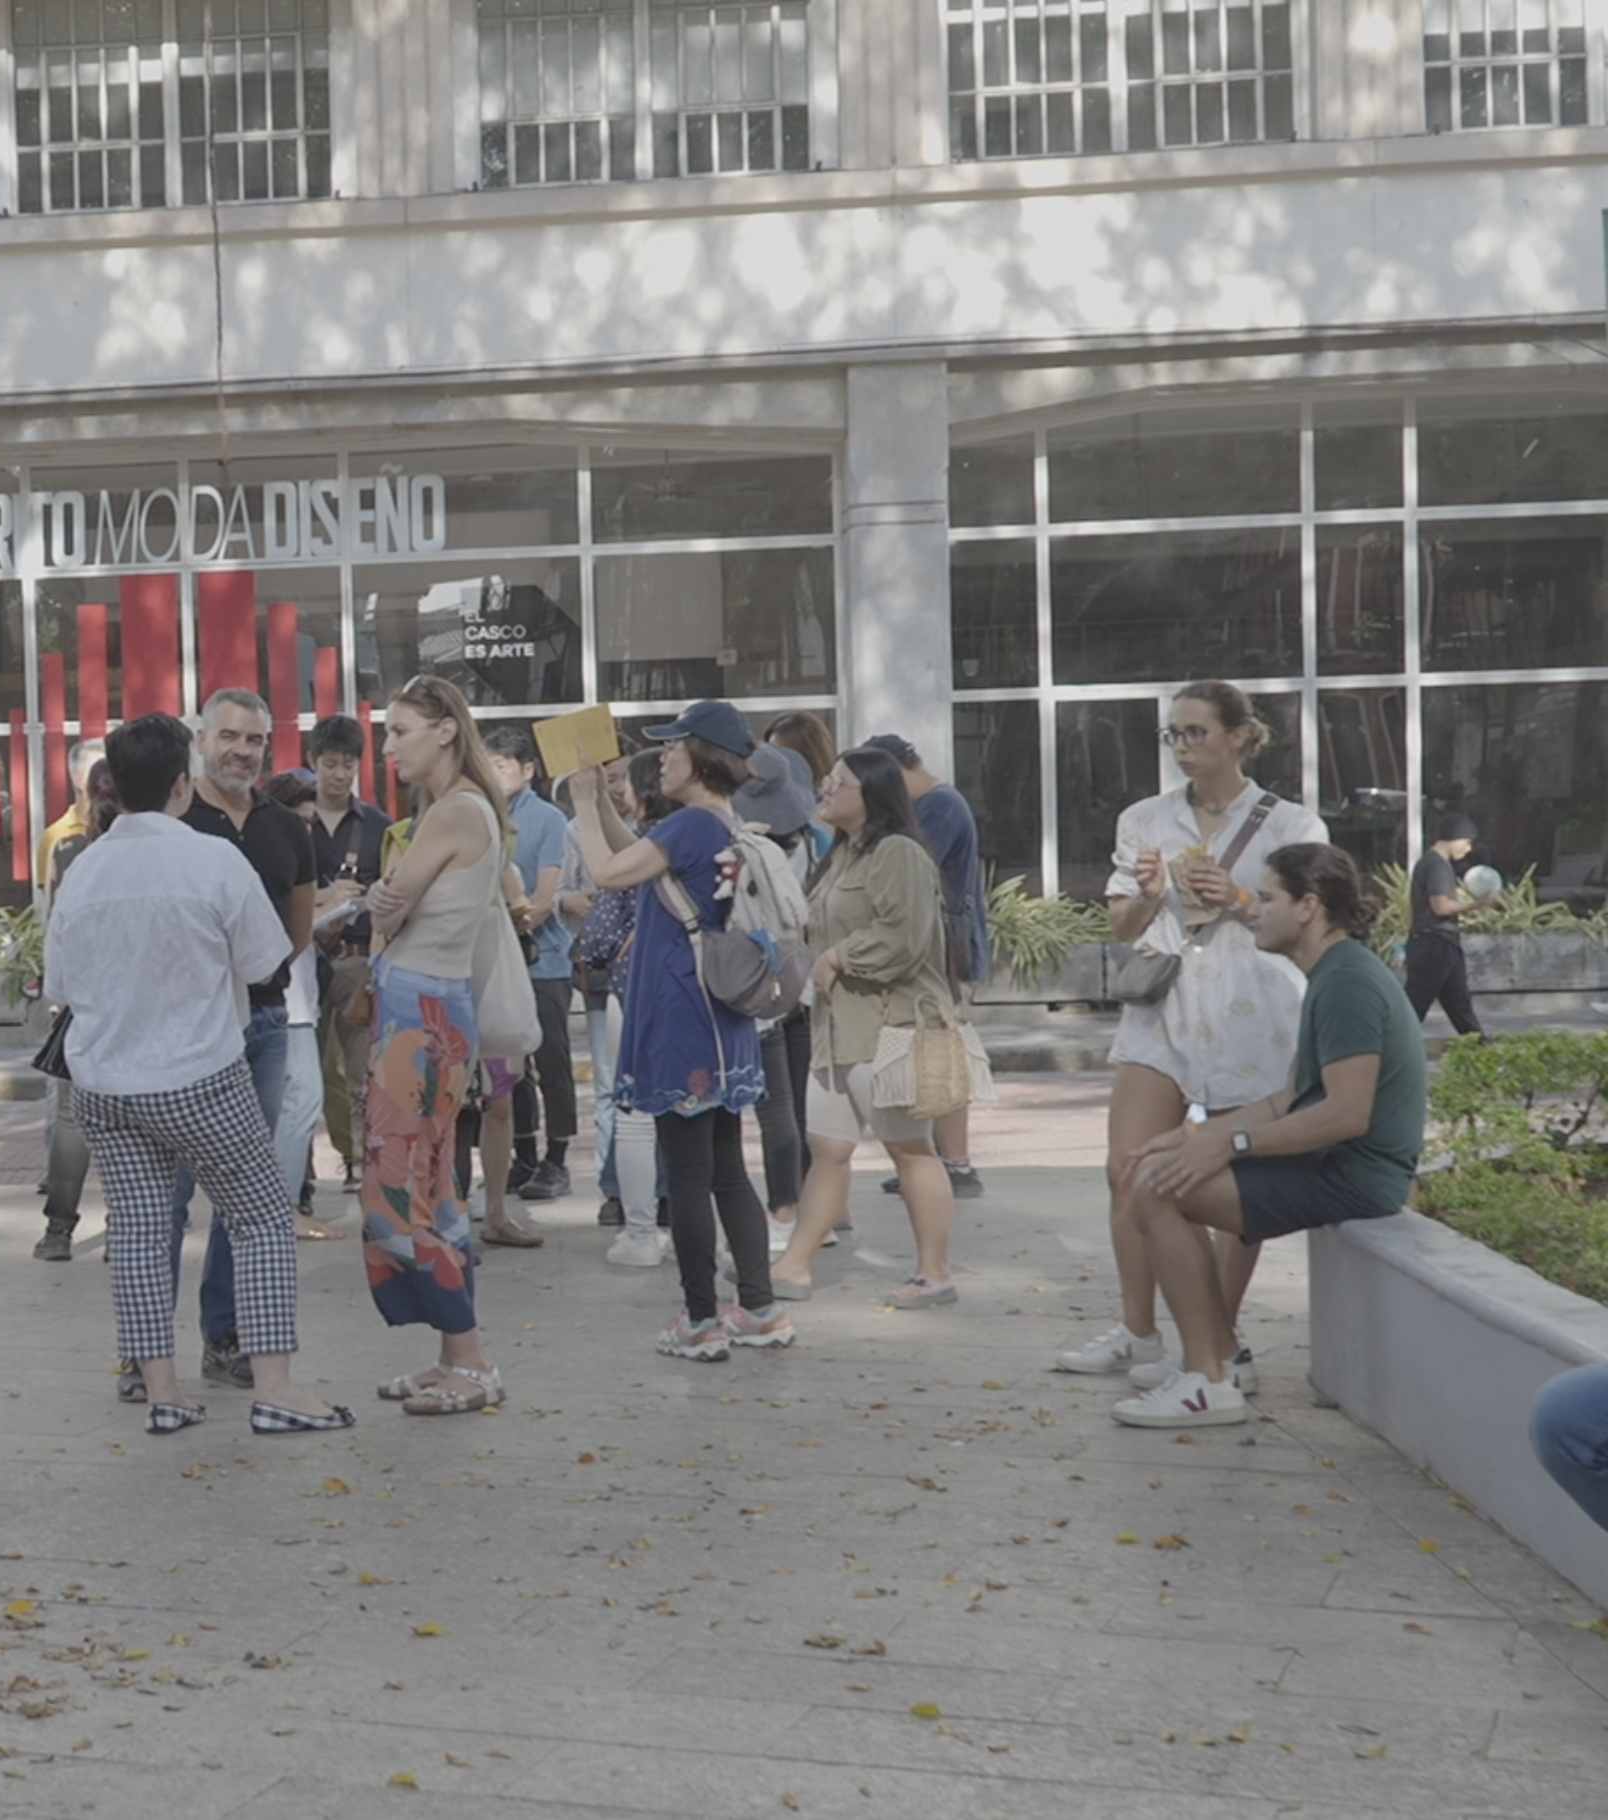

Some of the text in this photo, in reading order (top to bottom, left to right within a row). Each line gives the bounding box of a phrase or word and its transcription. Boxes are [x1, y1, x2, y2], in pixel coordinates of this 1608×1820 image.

[94, 484, 256, 566] MODA
[263, 462, 447, 560] DISEÑO
[464, 612, 485, 623] EL
[465, 625, 526, 640] CASCO
[464, 643, 535, 659] ES ARTE
